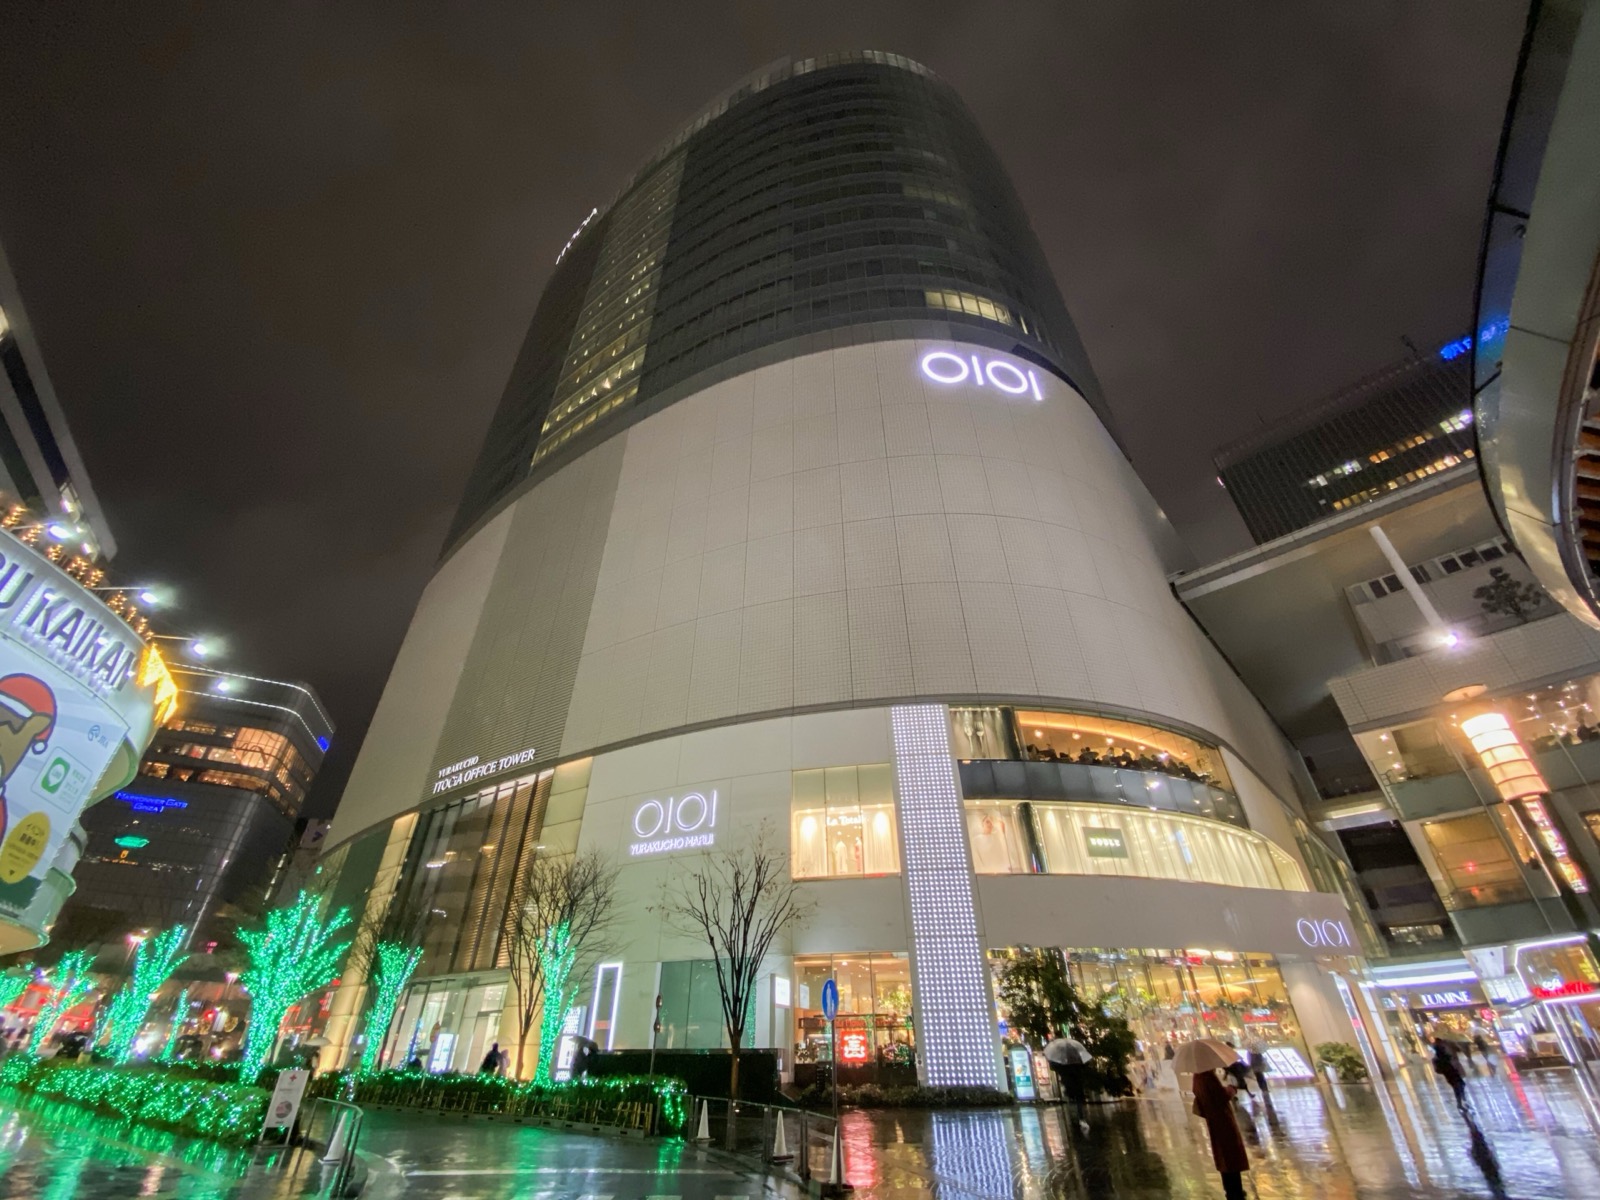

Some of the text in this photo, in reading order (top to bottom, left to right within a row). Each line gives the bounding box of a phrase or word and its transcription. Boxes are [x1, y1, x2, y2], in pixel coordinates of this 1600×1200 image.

[26, 587, 136, 692] KAIKAN
[438, 755, 479, 778] YURAKUCHO
[463, 761, 498, 783] OFFICE
[499, 748, 536, 771] TOWER
[630, 832, 715, 856] YURAKUCHO MARUI
[1420, 990, 1472, 1006] LUMINE
